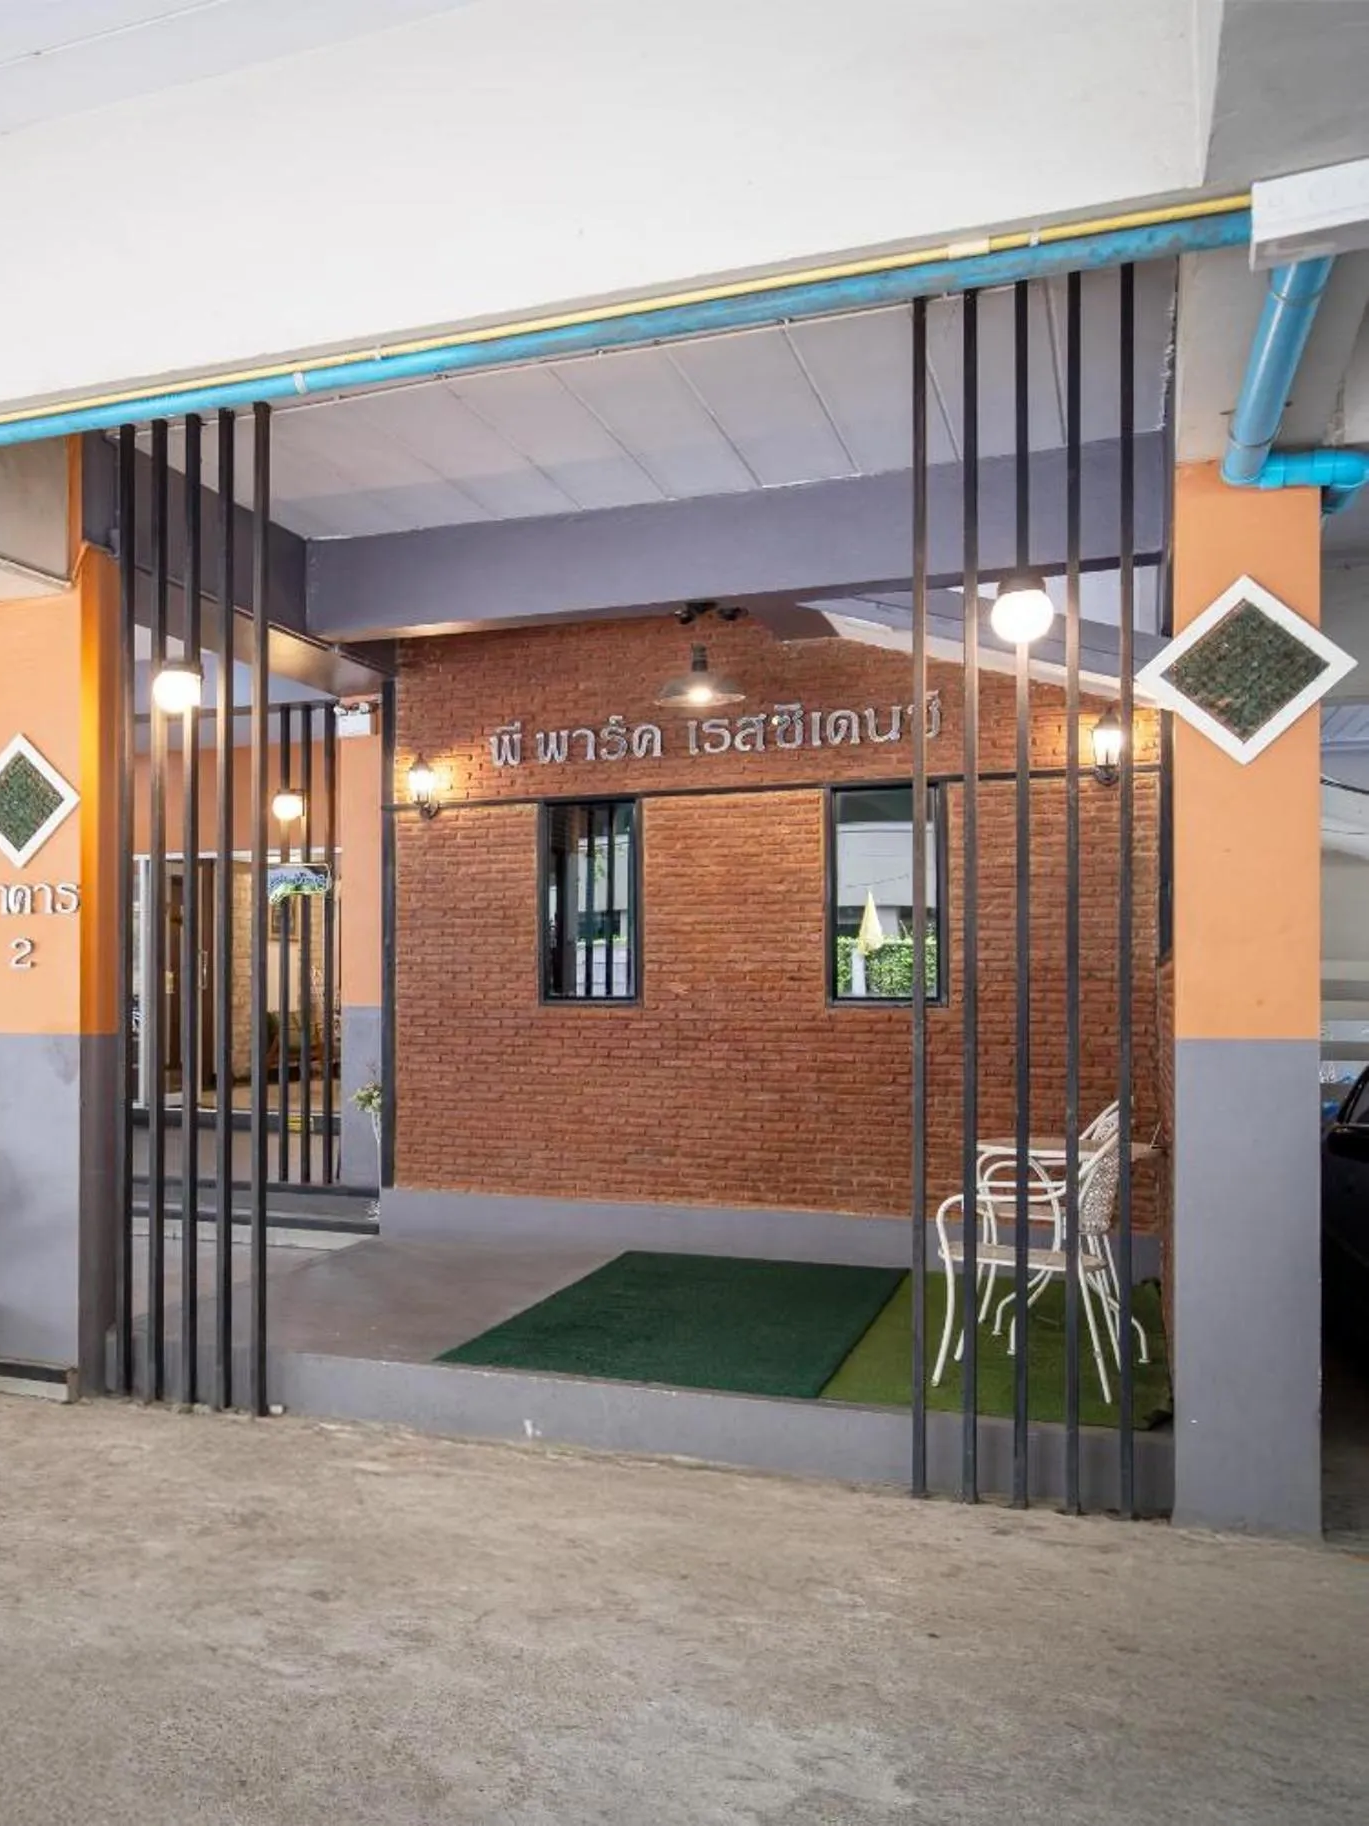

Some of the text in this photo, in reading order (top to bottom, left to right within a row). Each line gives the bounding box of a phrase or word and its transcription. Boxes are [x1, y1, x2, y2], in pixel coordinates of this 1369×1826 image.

[489, 720, 522, 766] พี
[535, 714, 663, 764] พาร์ค
[10, 937, 36, 968] 2
